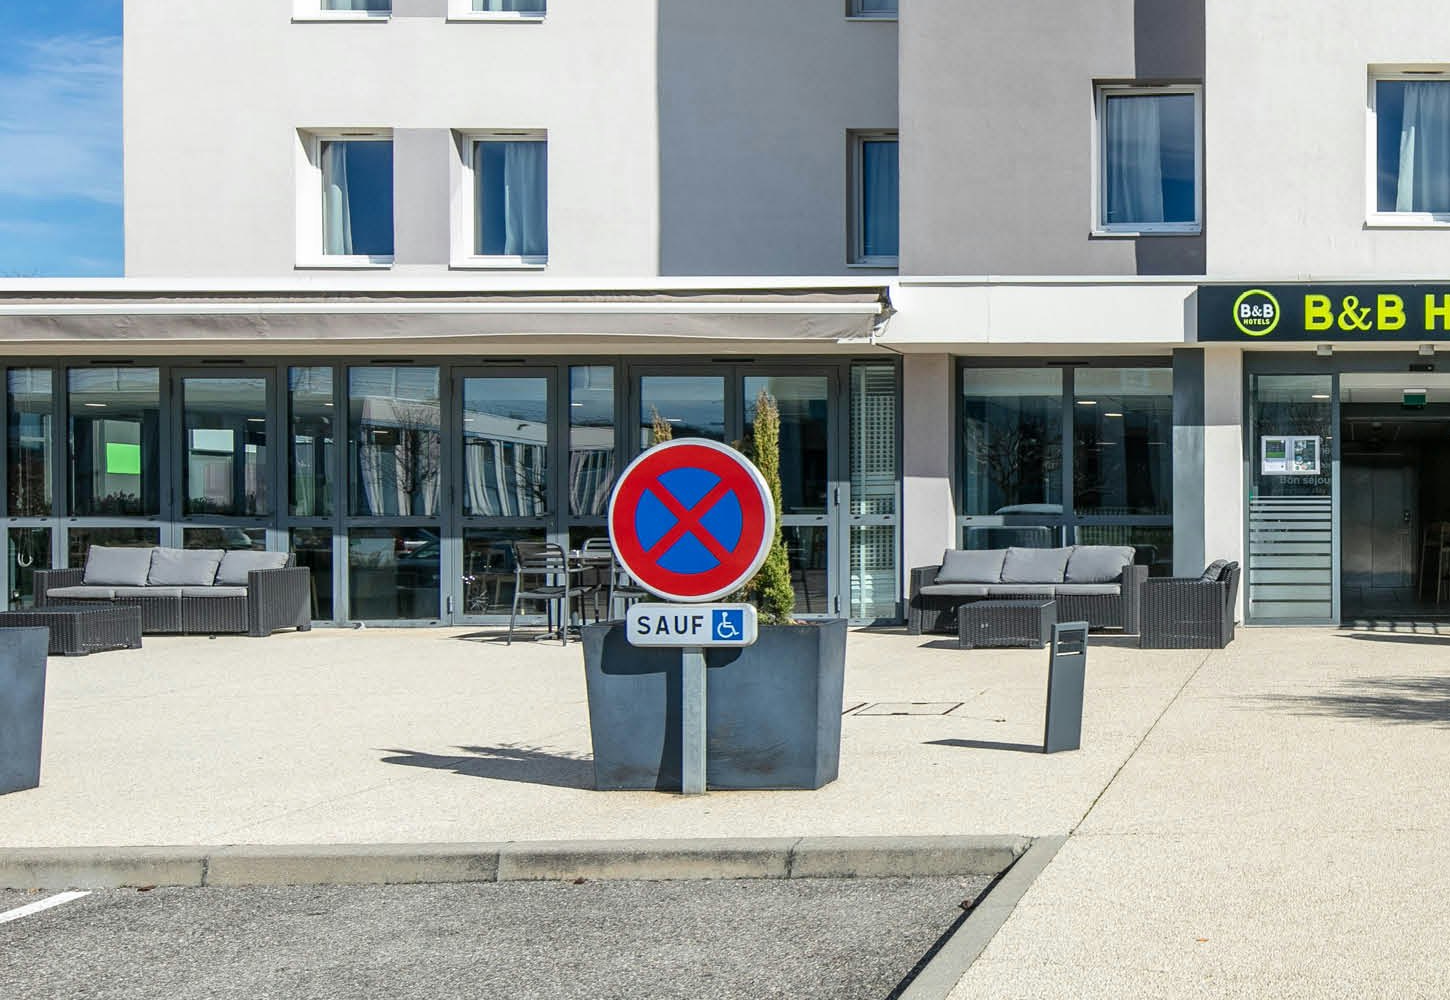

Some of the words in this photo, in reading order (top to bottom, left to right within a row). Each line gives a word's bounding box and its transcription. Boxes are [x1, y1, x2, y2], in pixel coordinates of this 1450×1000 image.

[1240, 303, 1274, 318] B&B
[1304, 293, 1407, 331] B&B
[637, 615, 704, 635] SAUF
